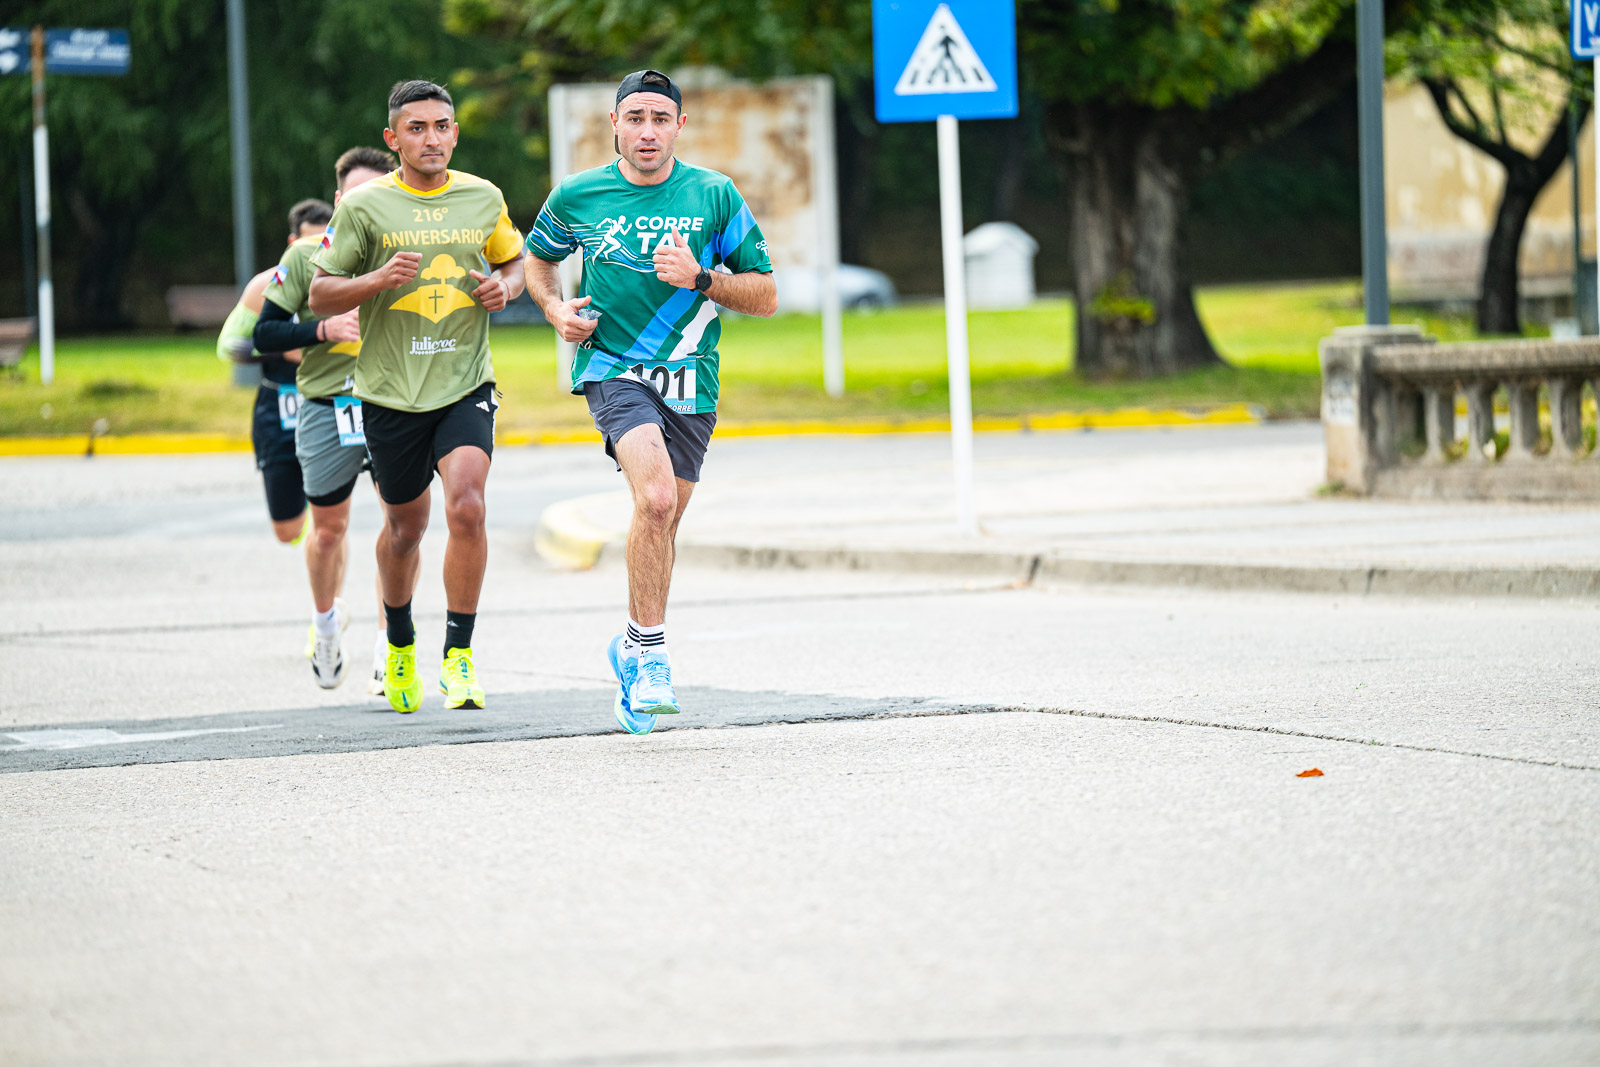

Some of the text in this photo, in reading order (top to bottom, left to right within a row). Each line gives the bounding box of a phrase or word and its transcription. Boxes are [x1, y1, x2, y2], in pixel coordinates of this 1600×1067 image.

[412, 207, 449, 223] 216°
[635, 216, 704, 231] CORRE
[382, 229, 484, 249] ANIVERSARIO
[409, 336, 457, 355] julicroc
